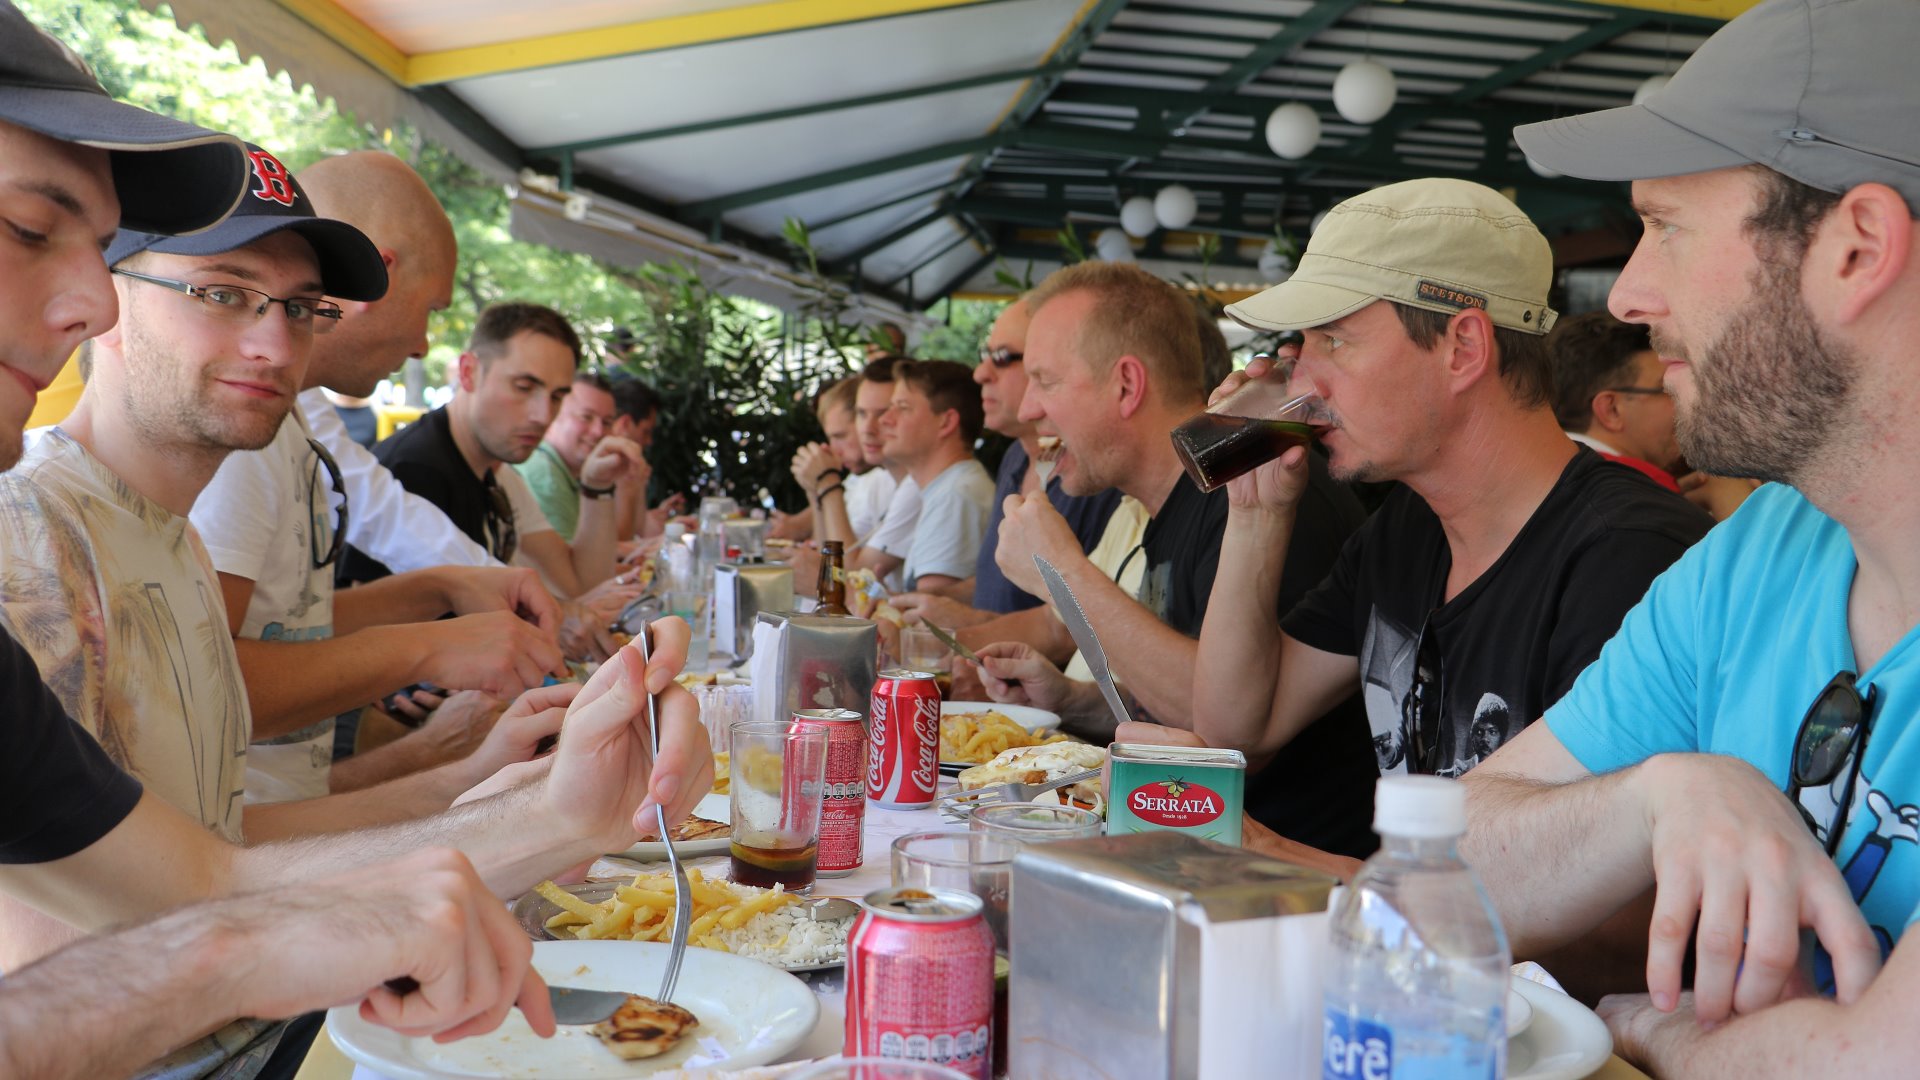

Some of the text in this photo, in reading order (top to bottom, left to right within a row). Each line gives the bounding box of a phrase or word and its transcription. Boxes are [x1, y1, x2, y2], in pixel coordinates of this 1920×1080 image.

[248, 150, 299, 207] B
[1420, 283, 1483, 307] STETSON
[1133, 792, 1217, 814] SERRATA
